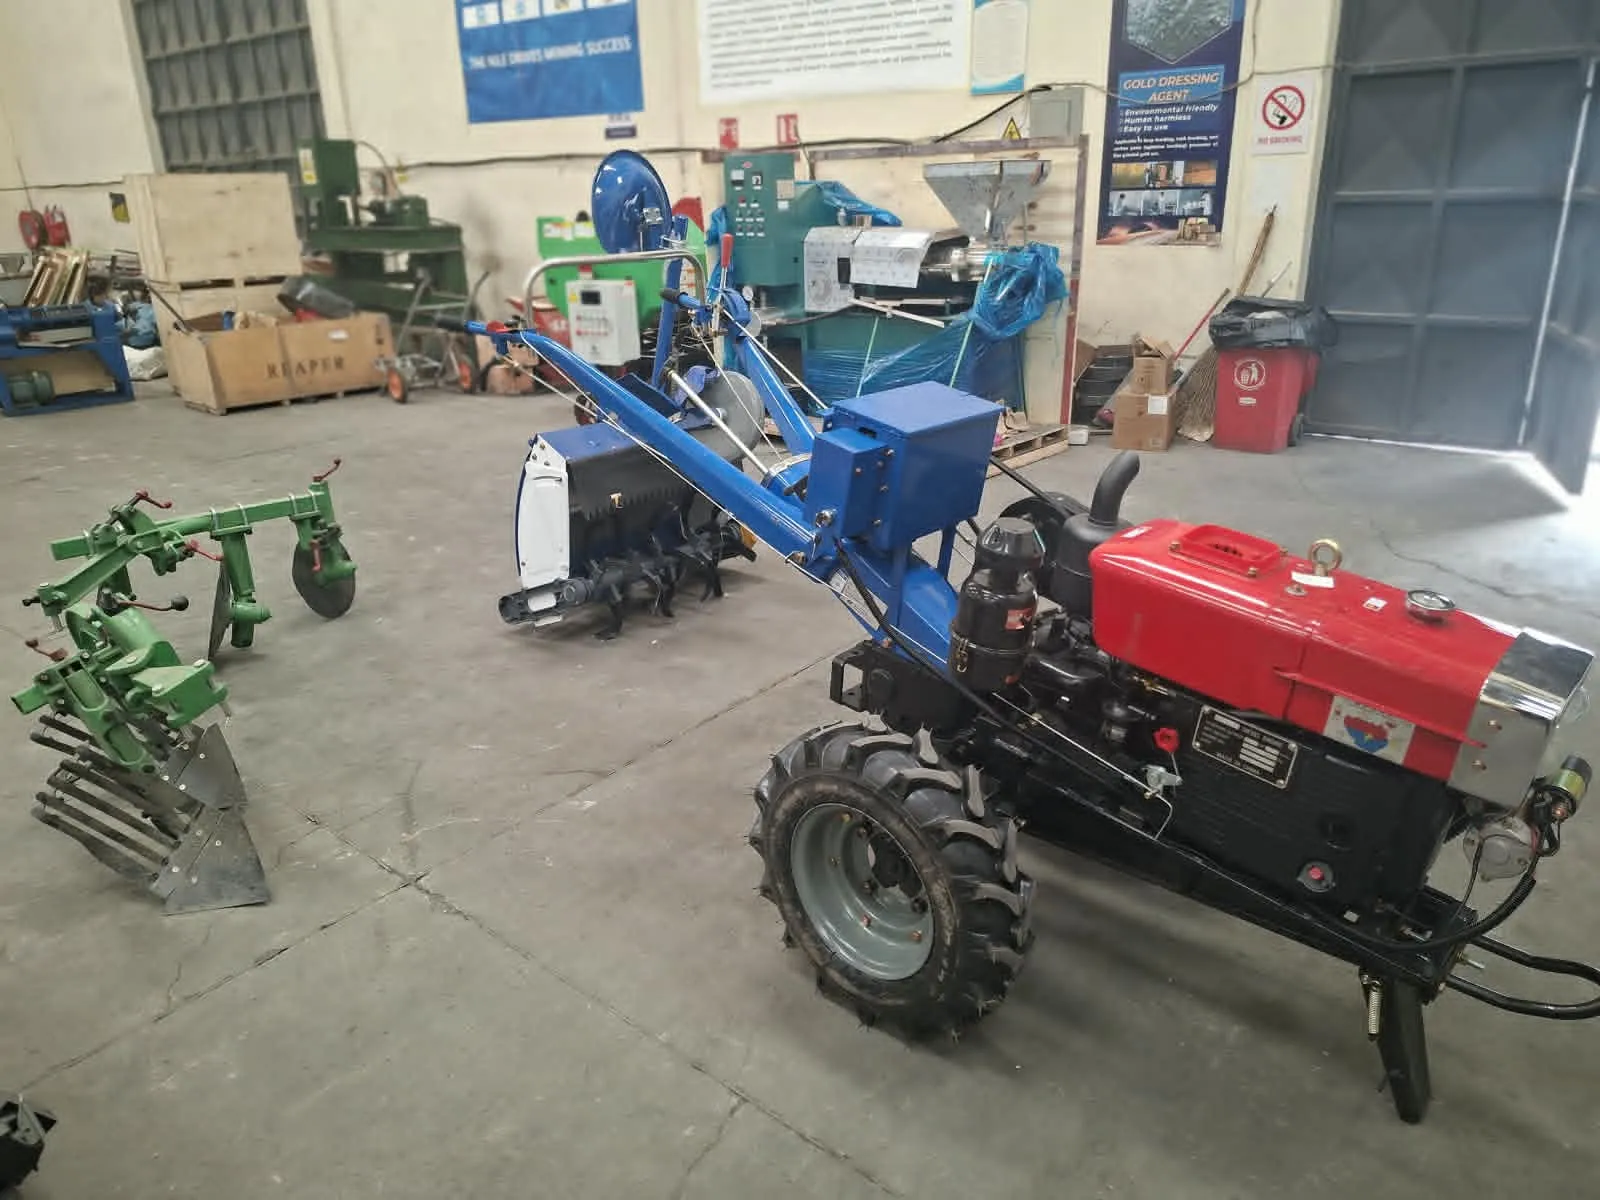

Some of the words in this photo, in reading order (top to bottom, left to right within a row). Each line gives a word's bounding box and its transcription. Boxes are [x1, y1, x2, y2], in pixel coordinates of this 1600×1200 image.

[585, 35, 633, 56] SUCCESS
[1123, 77, 1157, 90] GOLD
[1158, 71, 1220, 87] DRESSING
[1149, 89, 1189, 101] AGENT
[1124, 106, 1184, 117] Environmental
[1185, 103, 1218, 113] friendly
[1124, 116, 1152, 124] Human
[1154, 114, 1192, 123] harmless
[1123, 125, 1142, 134] Easy
[266, 355, 345, 379] REAPER
